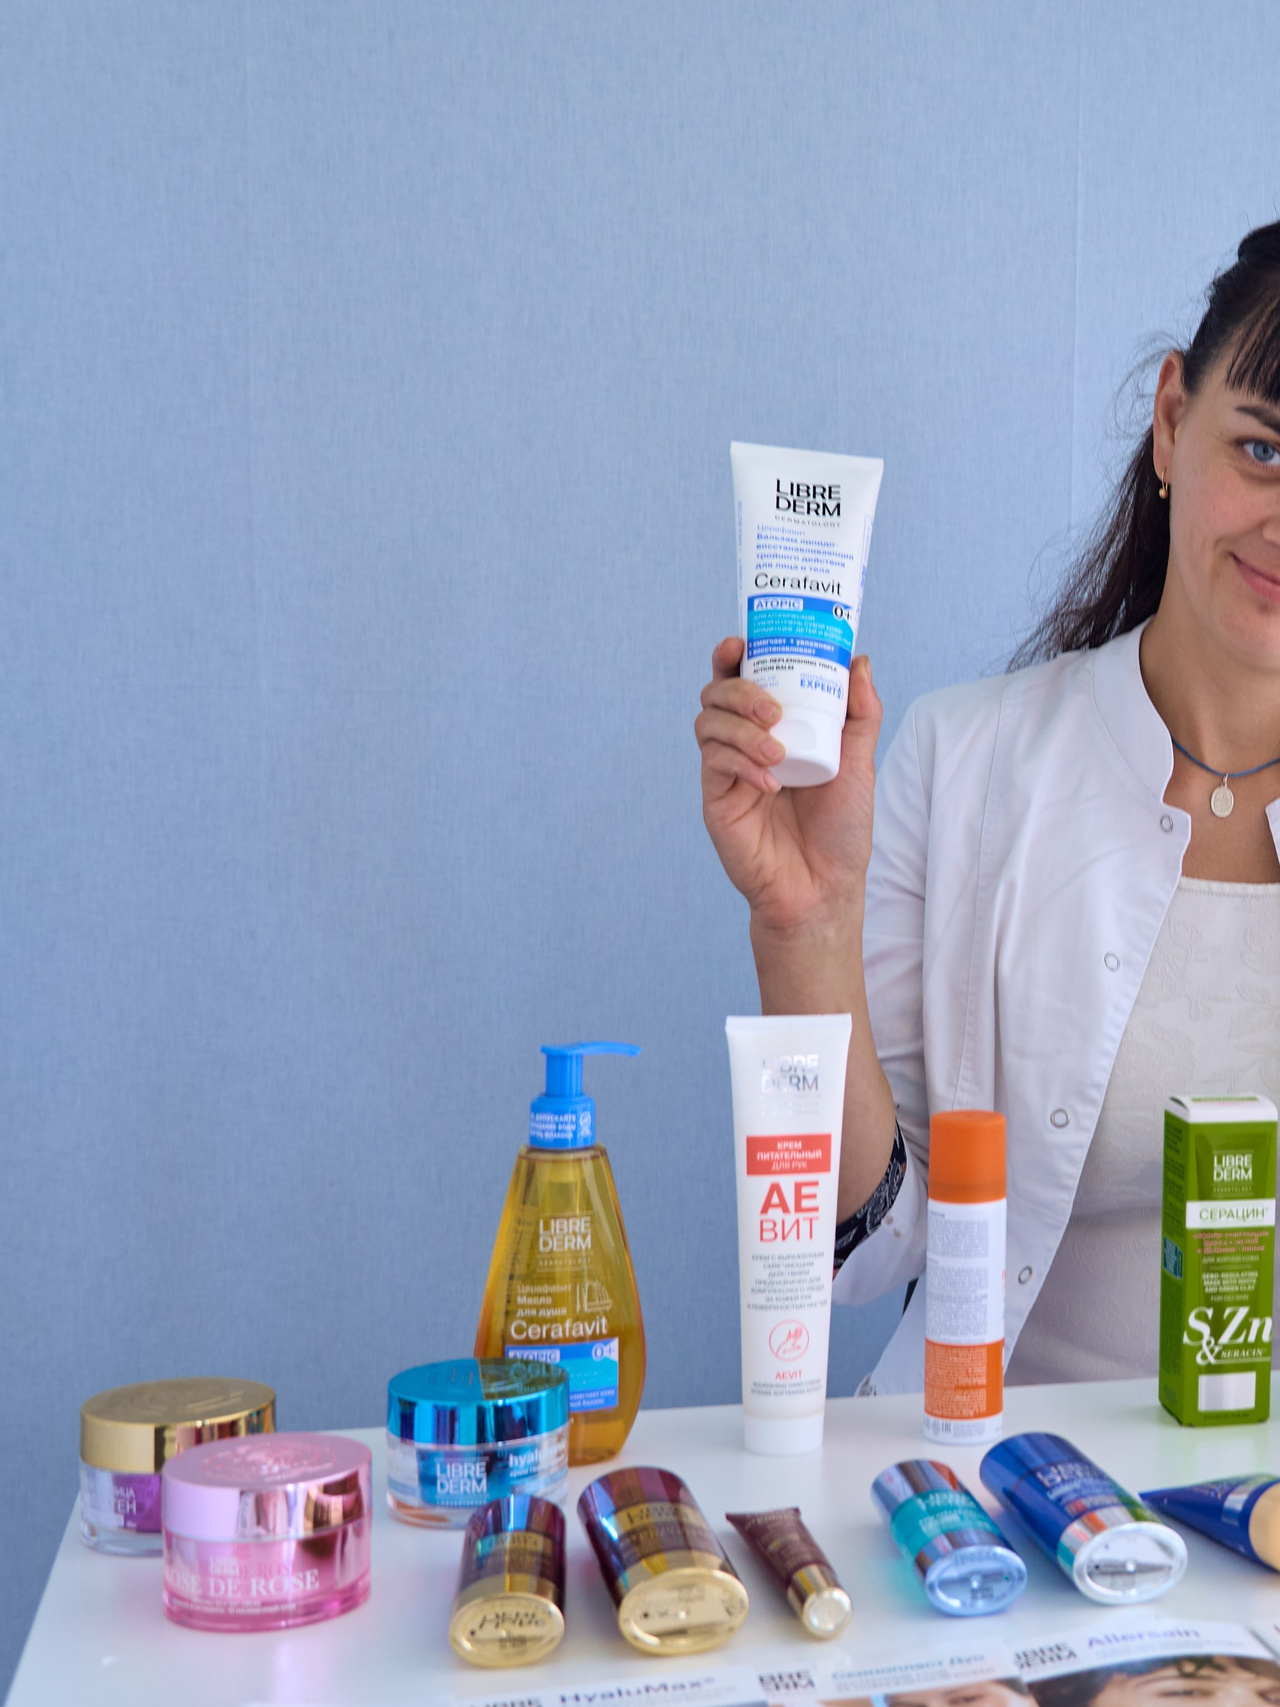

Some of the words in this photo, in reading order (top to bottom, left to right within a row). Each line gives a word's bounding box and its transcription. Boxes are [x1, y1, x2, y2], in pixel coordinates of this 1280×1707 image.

[776, 479, 841, 500] LIBRE
[776, 495, 841, 517] DERM
[754, 572, 843, 596] Cerafavit
[756, 598, 801, 610] ATOPIC
[776, 1140, 803, 1151] КРЕМ
[756, 1149, 822, 1161] ПИТАТЕЛЬНЫЙ
[1213, 1153, 1253, 1168] LIBRE
[771, 1160, 790, 1171] ДЛЯ
[791, 1159, 808, 1171] РУК
[1213, 1167, 1253, 1182] DERM
[760, 1180, 819, 1215] АЕ
[1199, 1207, 1266, 1222] СЕРАЦИН
[539, 1217, 591, 1235] LIBRE
[760, 1216, 819, 1243] ВИТ
[539, 1233, 592, 1252] DERM
[517, 1295, 552, 1305] Масло
[510, 1315, 608, 1340] Cerafavit
[775, 1370, 803, 1380] AEVIT
[435, 1461, 488, 1479] LIBRE
[113, 1486, 136, 1499] ИЦА
[436, 1478, 488, 1495] DERM
[209, 1579, 242, 1598] DE
[250, 1568, 320, 1595] ROSE
